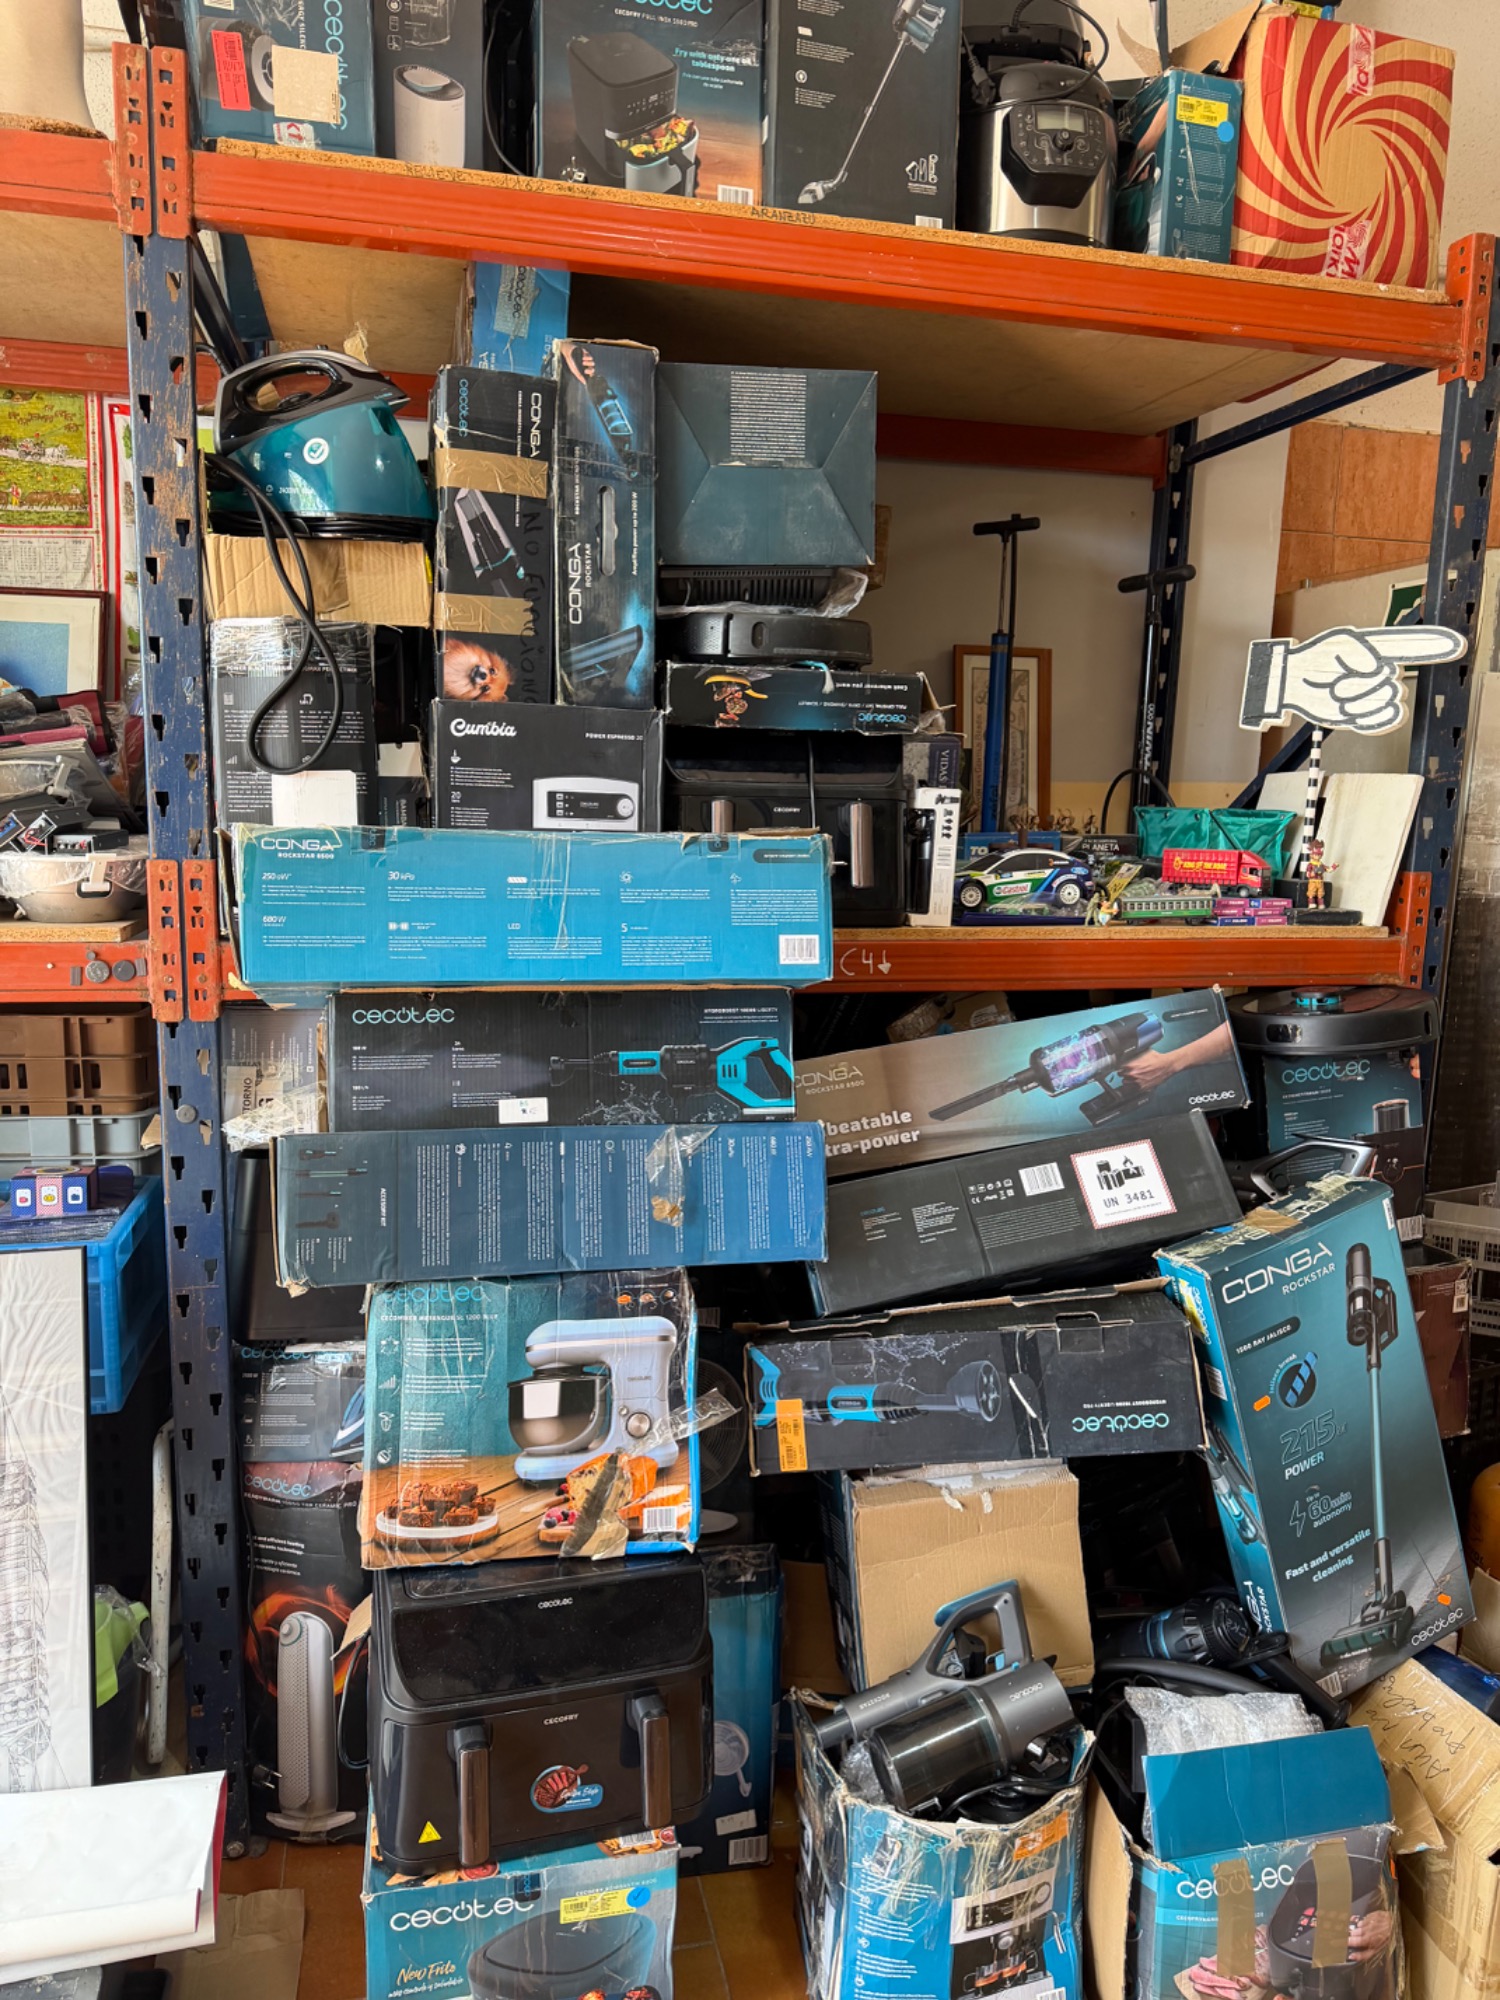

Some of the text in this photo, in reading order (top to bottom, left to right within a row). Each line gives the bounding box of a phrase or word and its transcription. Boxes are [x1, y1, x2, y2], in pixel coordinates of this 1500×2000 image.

[458, 378, 469, 437] cecotec
[530, 392, 542, 458] CONGA
[522, 511, 544, 556] NO
[568, 542, 583, 625] CONGA
[449, 717, 518, 738] Cumbia
[858, 712, 907, 724] cecotec
[585, 732, 606, 740] POWER
[606, 733, 635, 741] ESPRESSO
[940, 749, 950, 783] VIDAS
[450, 791, 462, 800] 20
[261, 838, 335, 852] CONGA
[277, 852, 315, 860] ROCKSTAR
[388, 871, 400, 881] 30
[1001, 883, 1029, 896] Castrol
[352, 1006, 455, 1025] cecotec
[795, 1065, 863, 1088] CONGA
[1281, 1059, 1371, 1085] cecotec
[806, 1082, 846, 1095] ROCKSTAR
[1188, 1088, 1236, 1106] cecotec
[824, 1110, 912, 1137] beatable
[825, 1128, 920, 1159] tra-power
[1103, 1189, 1155, 1210] UN 3481
[1221, 1241, 1333, 1304] CONGA
[1281, 1262, 1337, 1296] ROCKSTAR
[1072, 1412, 1170, 1433] cecotec
[1280, 1409, 1336, 1465] 215
[1284, 1450, 1325, 1480] POWER
[244, 1474, 311, 1498] cecotec
[1312, 1502, 1353, 1528] autonomy
[1285, 1528, 1372, 1580] Fast and versatile
[1312, 1555, 1354, 1583] cleaning
[537, 1598, 574, 1609] cecotec
[1410, 1607, 1465, 1647] cecotec
[1009, 1682, 1044, 1701] cecotec
[543, 1713, 579, 1726] CECOFRY
[396, 1964, 429, 1986] New
